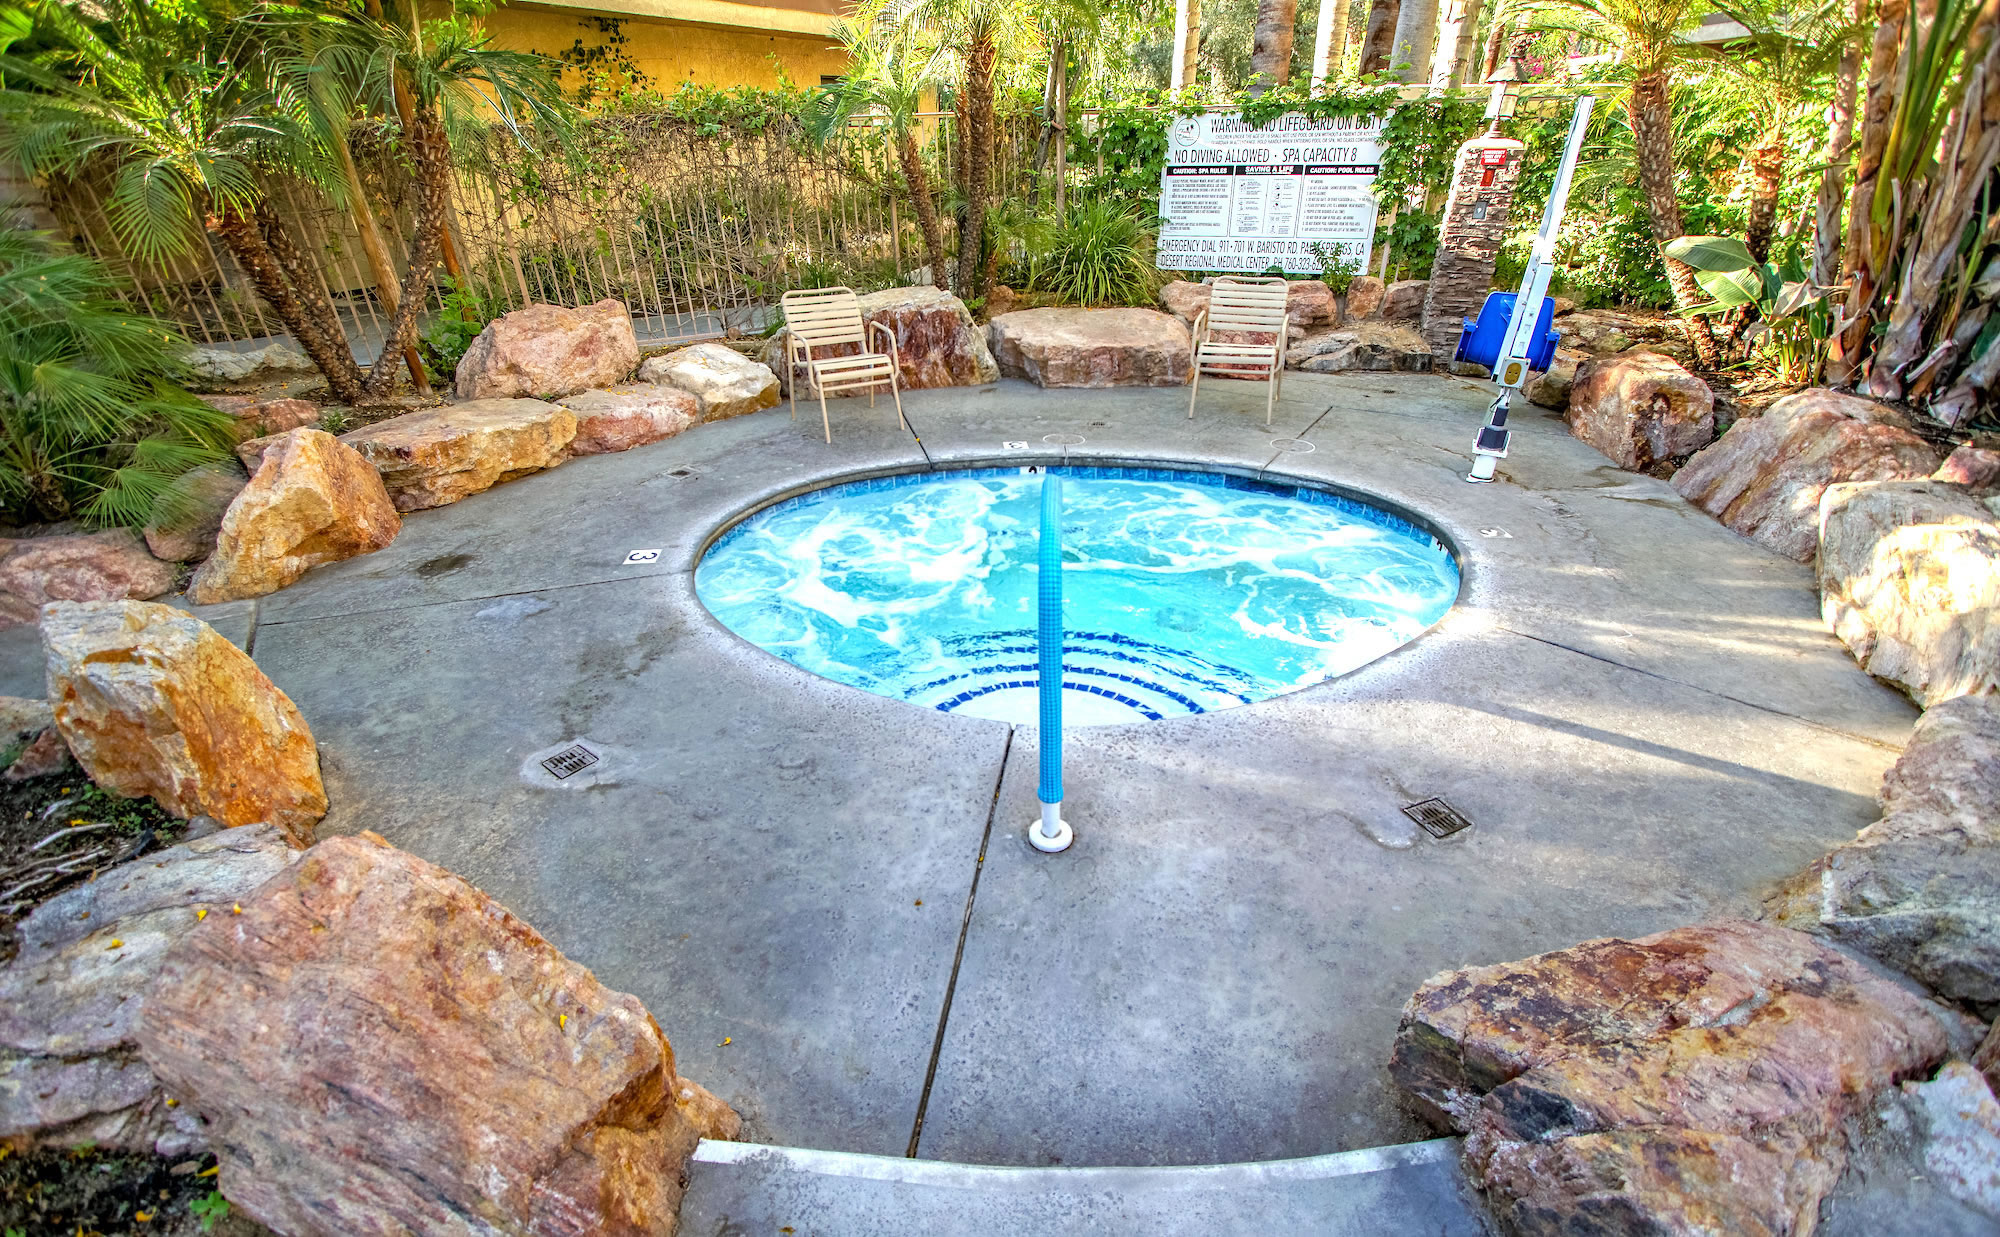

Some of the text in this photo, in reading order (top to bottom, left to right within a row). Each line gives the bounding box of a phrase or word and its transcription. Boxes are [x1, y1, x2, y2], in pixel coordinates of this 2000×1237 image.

[1261, 117, 1276, 132] NO
[1279, 115, 1334, 131] LIFEGUARD
[1338, 115, 1353, 130] ON
[1175, 147, 1358, 164] NO DIVING ALLOWED SPA CAPACITY 8
[1162, 239, 1200, 252] EMERGENCY
[1201, 240, 1217, 252] DIAL
[1219, 240, 1230, 253] 911
[1247, 240, 1255, 253] W.
[1256, 240, 1286, 254] BARISTO
[1300, 241, 1320, 255] PAL
[1320, 241, 1353, 257] SPRGS,
[1355, 242, 1365, 256] CA
[1161, 254, 1184, 267] DESERT
[1184, 255, 1216, 268] REGIONAL
[1216, 255, 1244, 268] MEDICAL
[628, 552, 658, 561] 3
